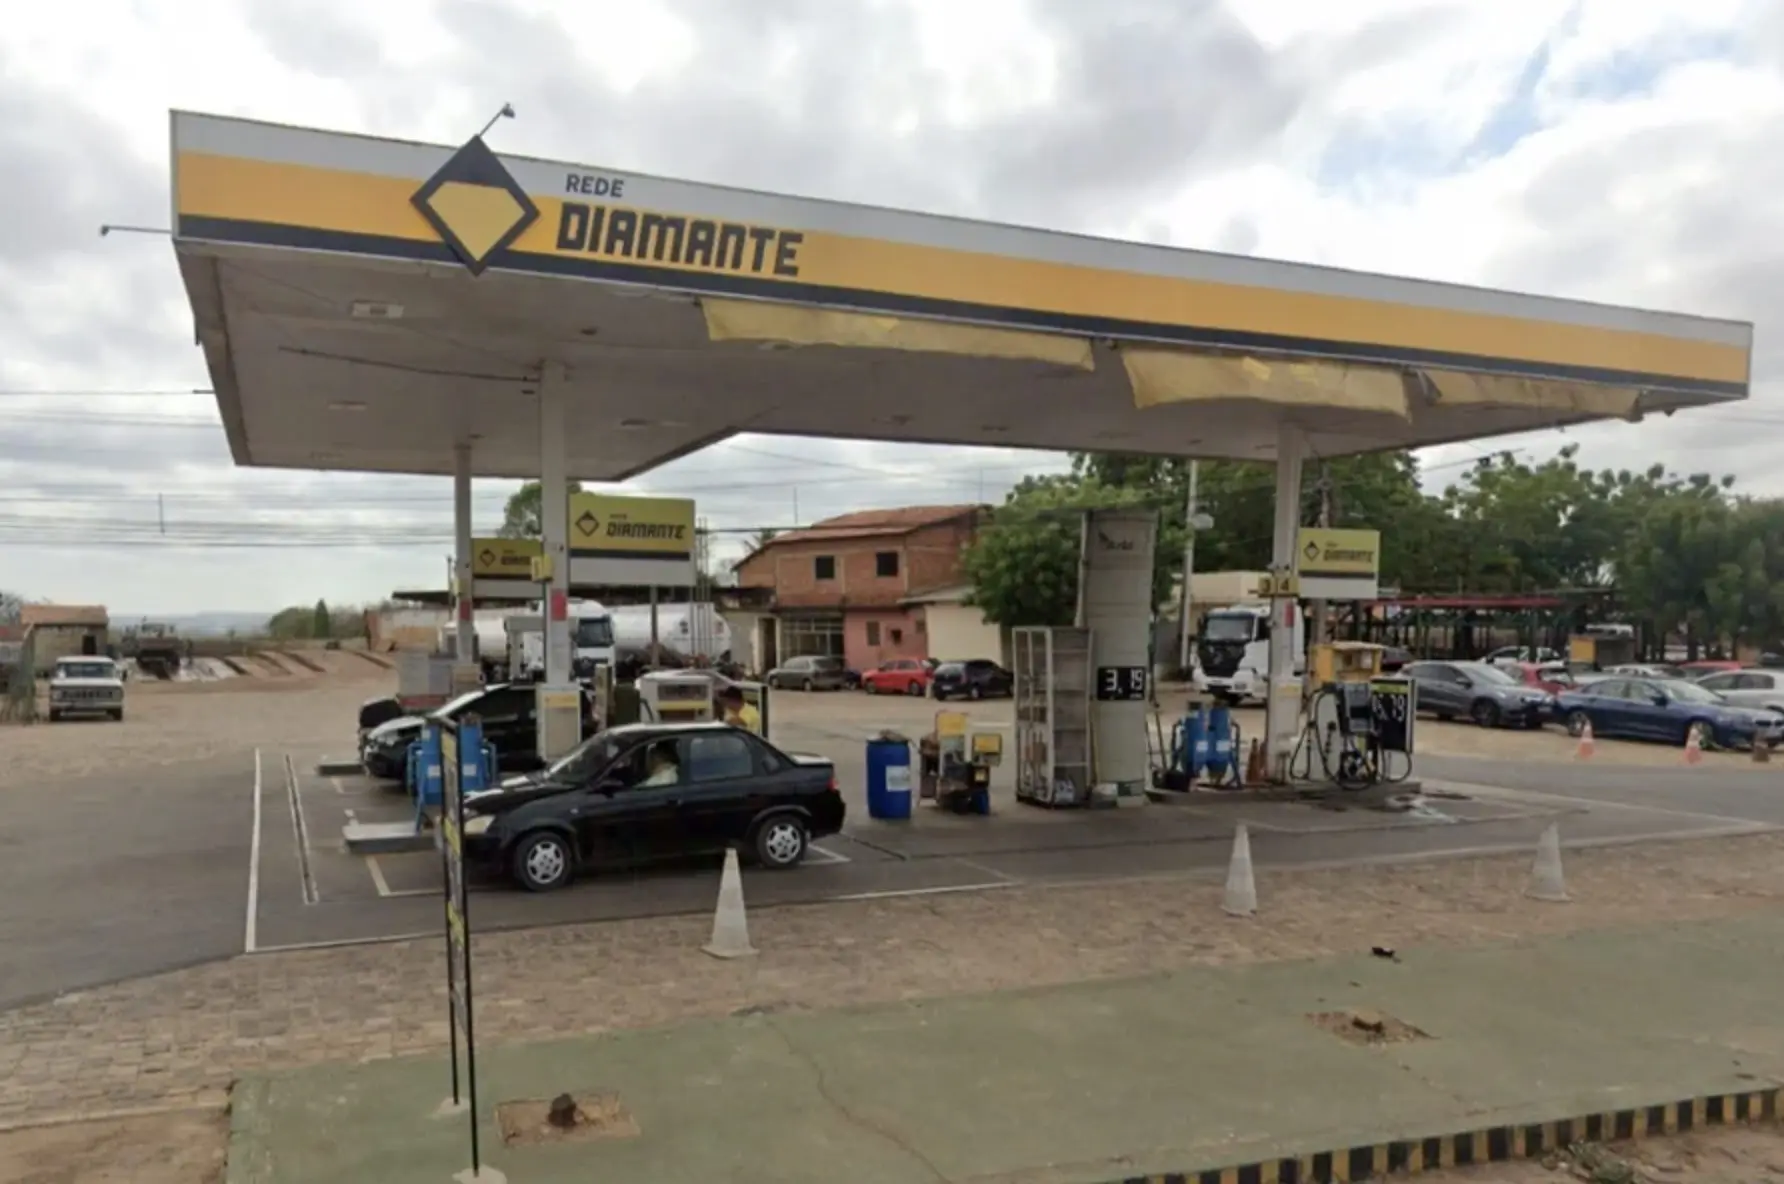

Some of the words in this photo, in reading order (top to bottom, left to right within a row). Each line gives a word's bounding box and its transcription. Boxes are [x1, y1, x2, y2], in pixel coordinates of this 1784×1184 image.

[565, 174, 624, 199] REDE
[556, 202, 804, 276] DIAMANTE
[606, 521, 686, 540] DIAMANTE
